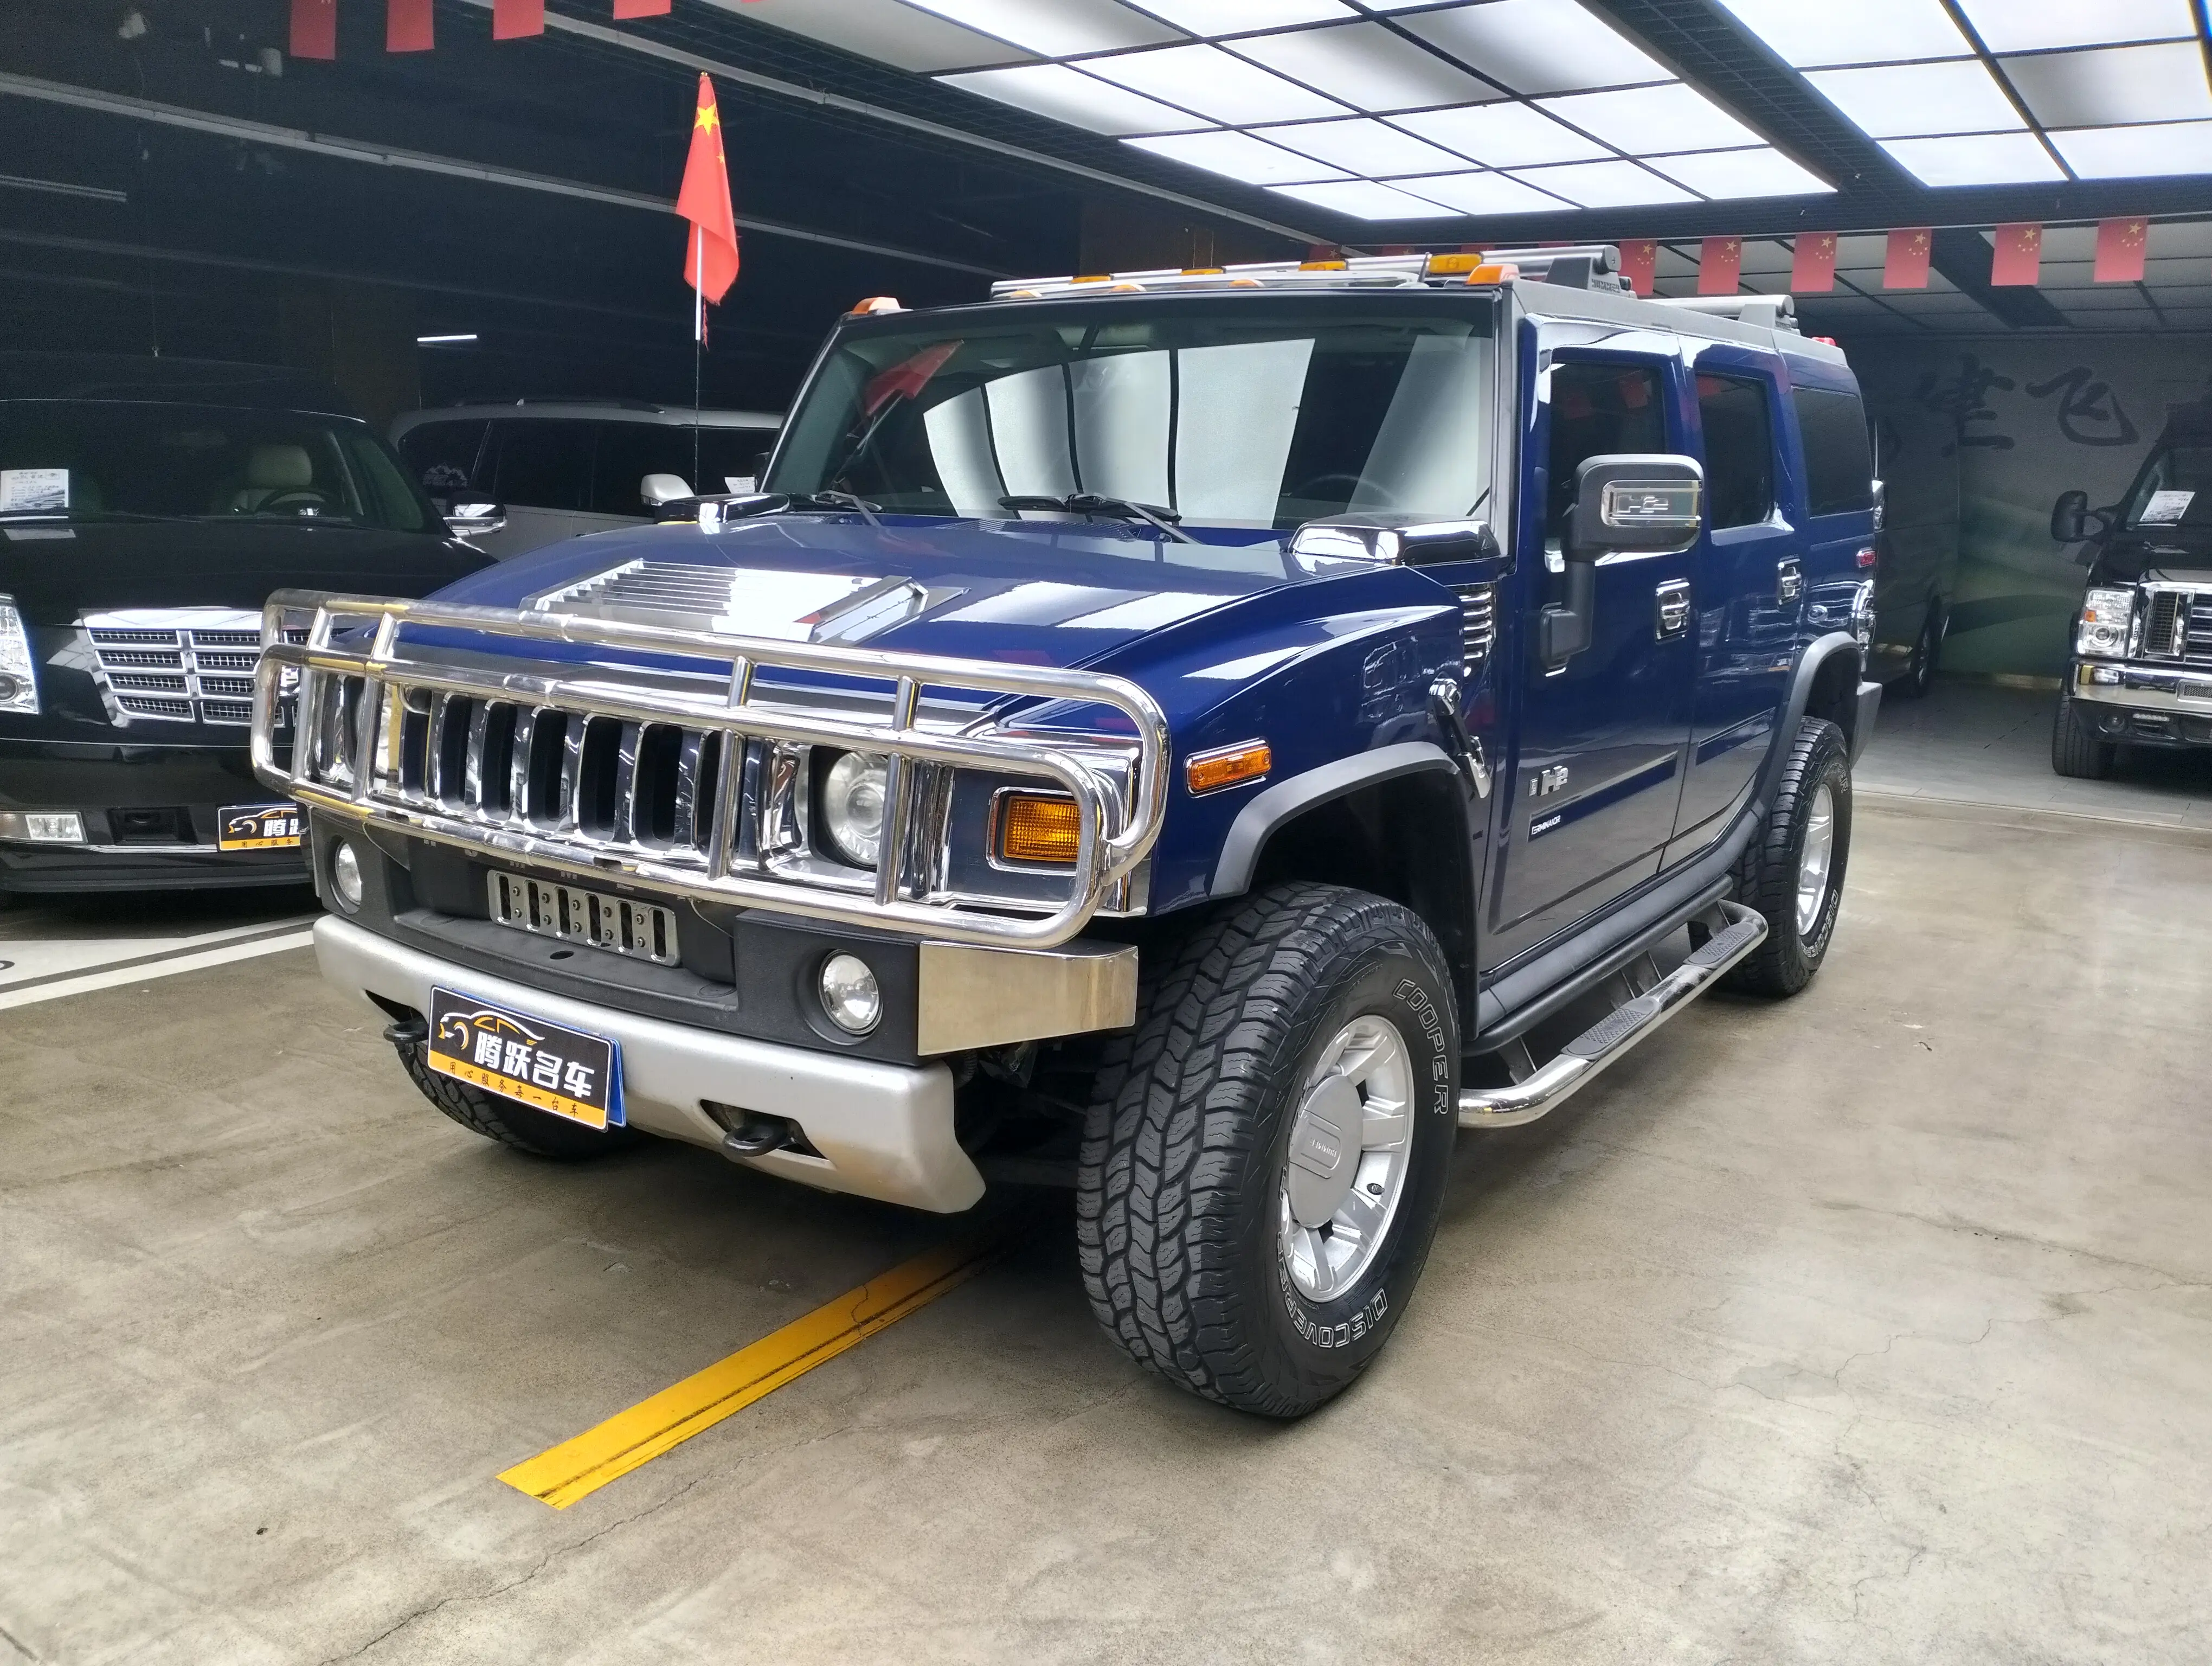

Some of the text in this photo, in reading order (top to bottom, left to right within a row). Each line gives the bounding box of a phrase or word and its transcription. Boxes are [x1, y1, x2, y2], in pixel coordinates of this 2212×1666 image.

[474, 1030, 595, 1098] 腾跃名车
[1393, 978, 1449, 1114] COOPER
[448, 1061, 579, 1118] 用心服务每一台车
